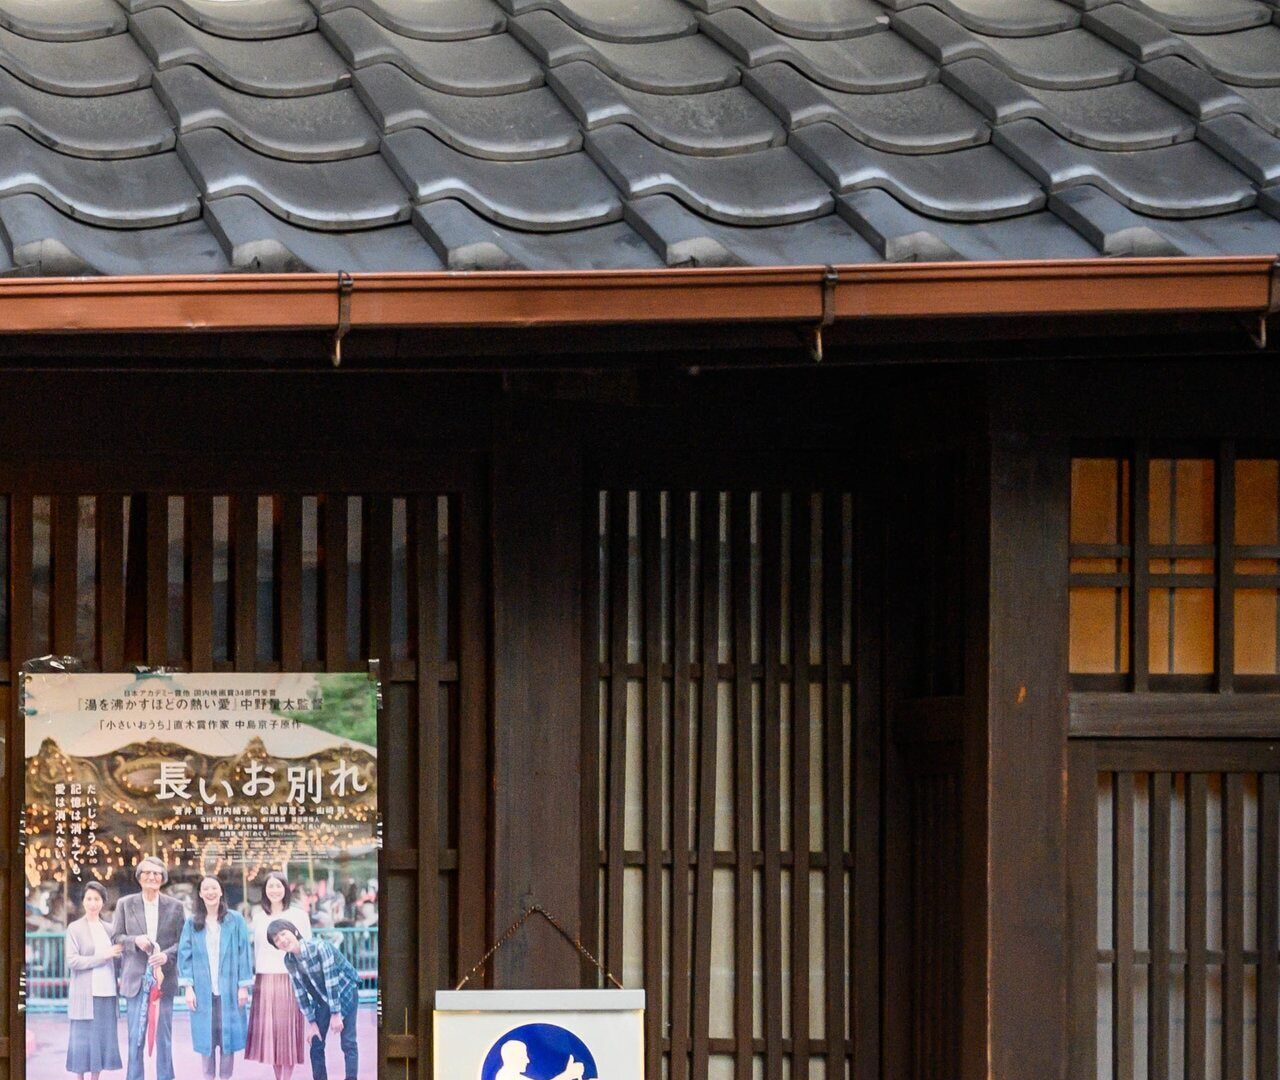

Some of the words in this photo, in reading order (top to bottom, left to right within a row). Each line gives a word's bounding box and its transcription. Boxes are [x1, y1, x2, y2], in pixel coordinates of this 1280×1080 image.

[155, 760, 367, 804] 長いお別れ
